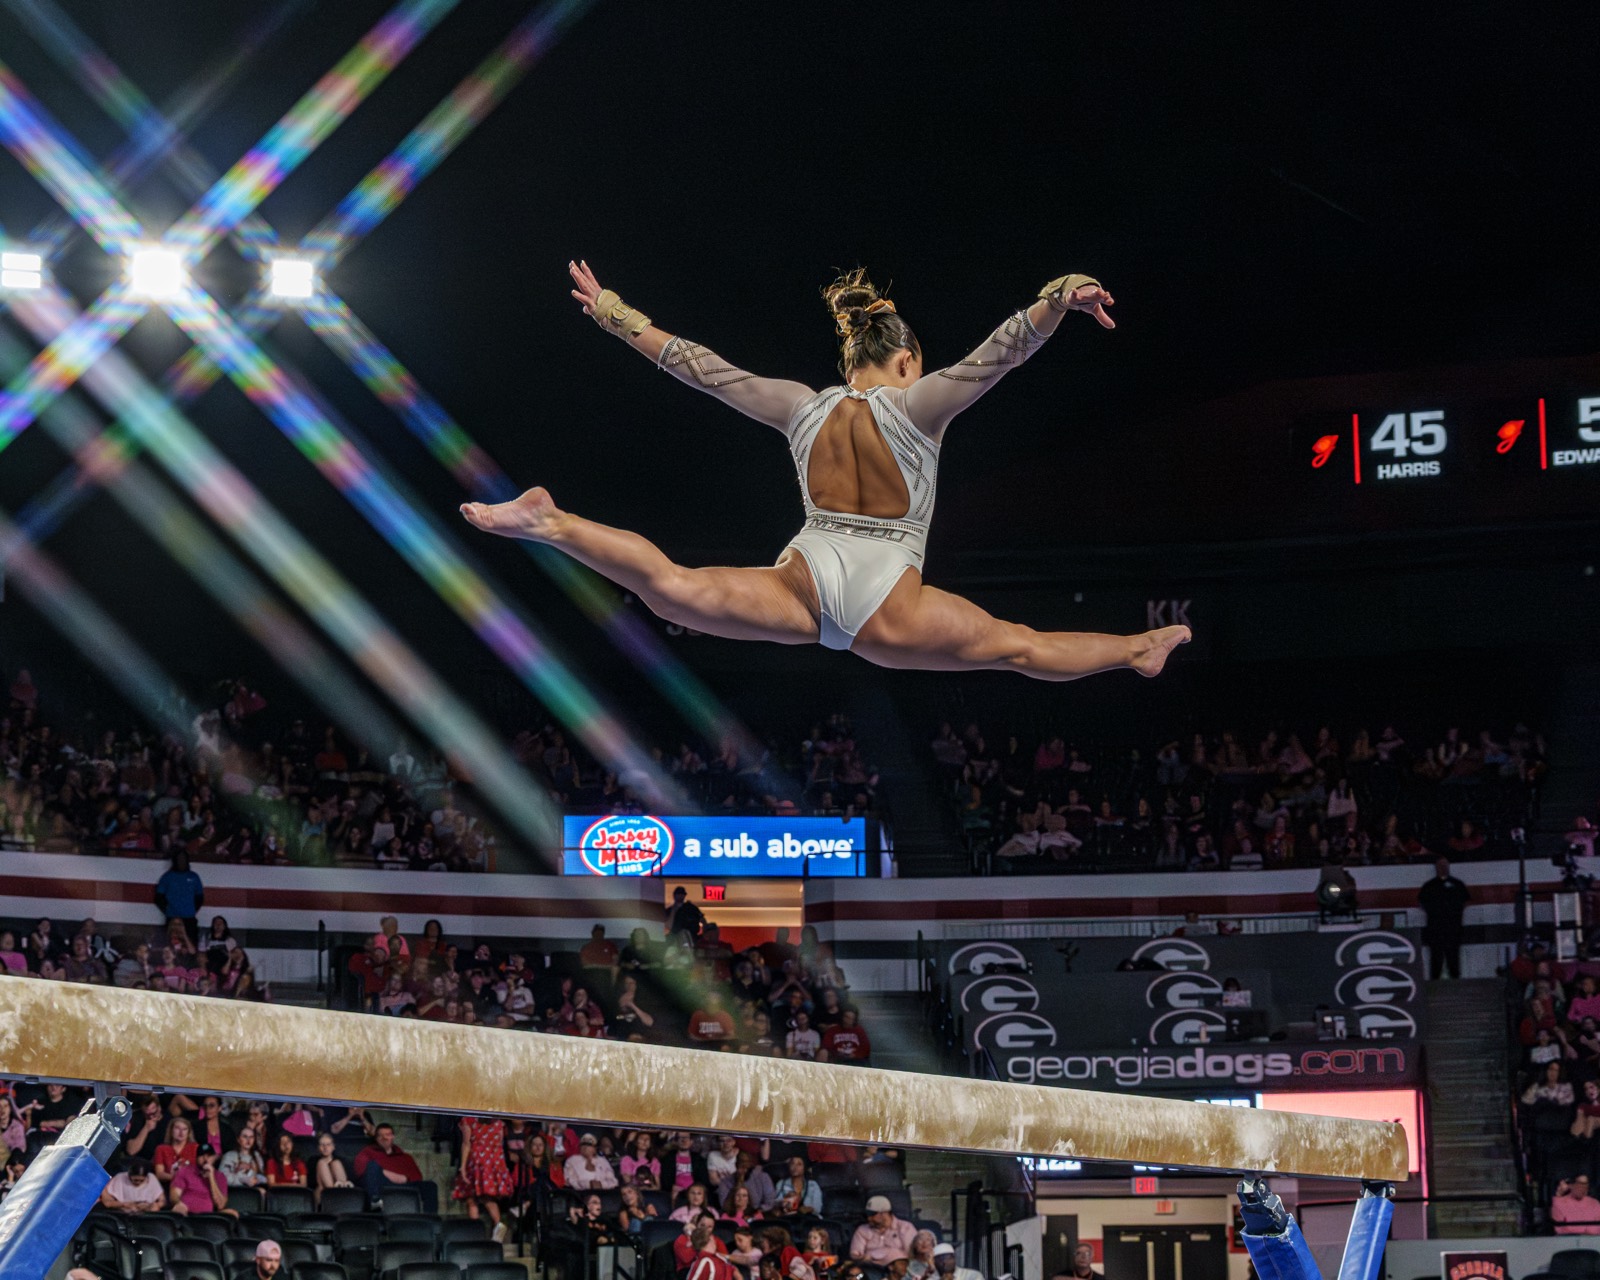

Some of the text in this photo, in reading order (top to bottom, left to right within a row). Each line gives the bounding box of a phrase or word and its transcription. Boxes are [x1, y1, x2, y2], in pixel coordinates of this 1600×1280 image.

[1370, 410, 1448, 457] 45
[1377, 461, 1441, 479] HARRIS
[1147, 600, 1192, 629] KK
[592, 827, 660, 849] Jersey
[683, 832, 852, 859] a sub above
[705, 886, 725, 900] EXIT
[1007, 1047, 1405, 1086] georgiadogs.com
[1135, 1177, 1156, 1193] EXIT
